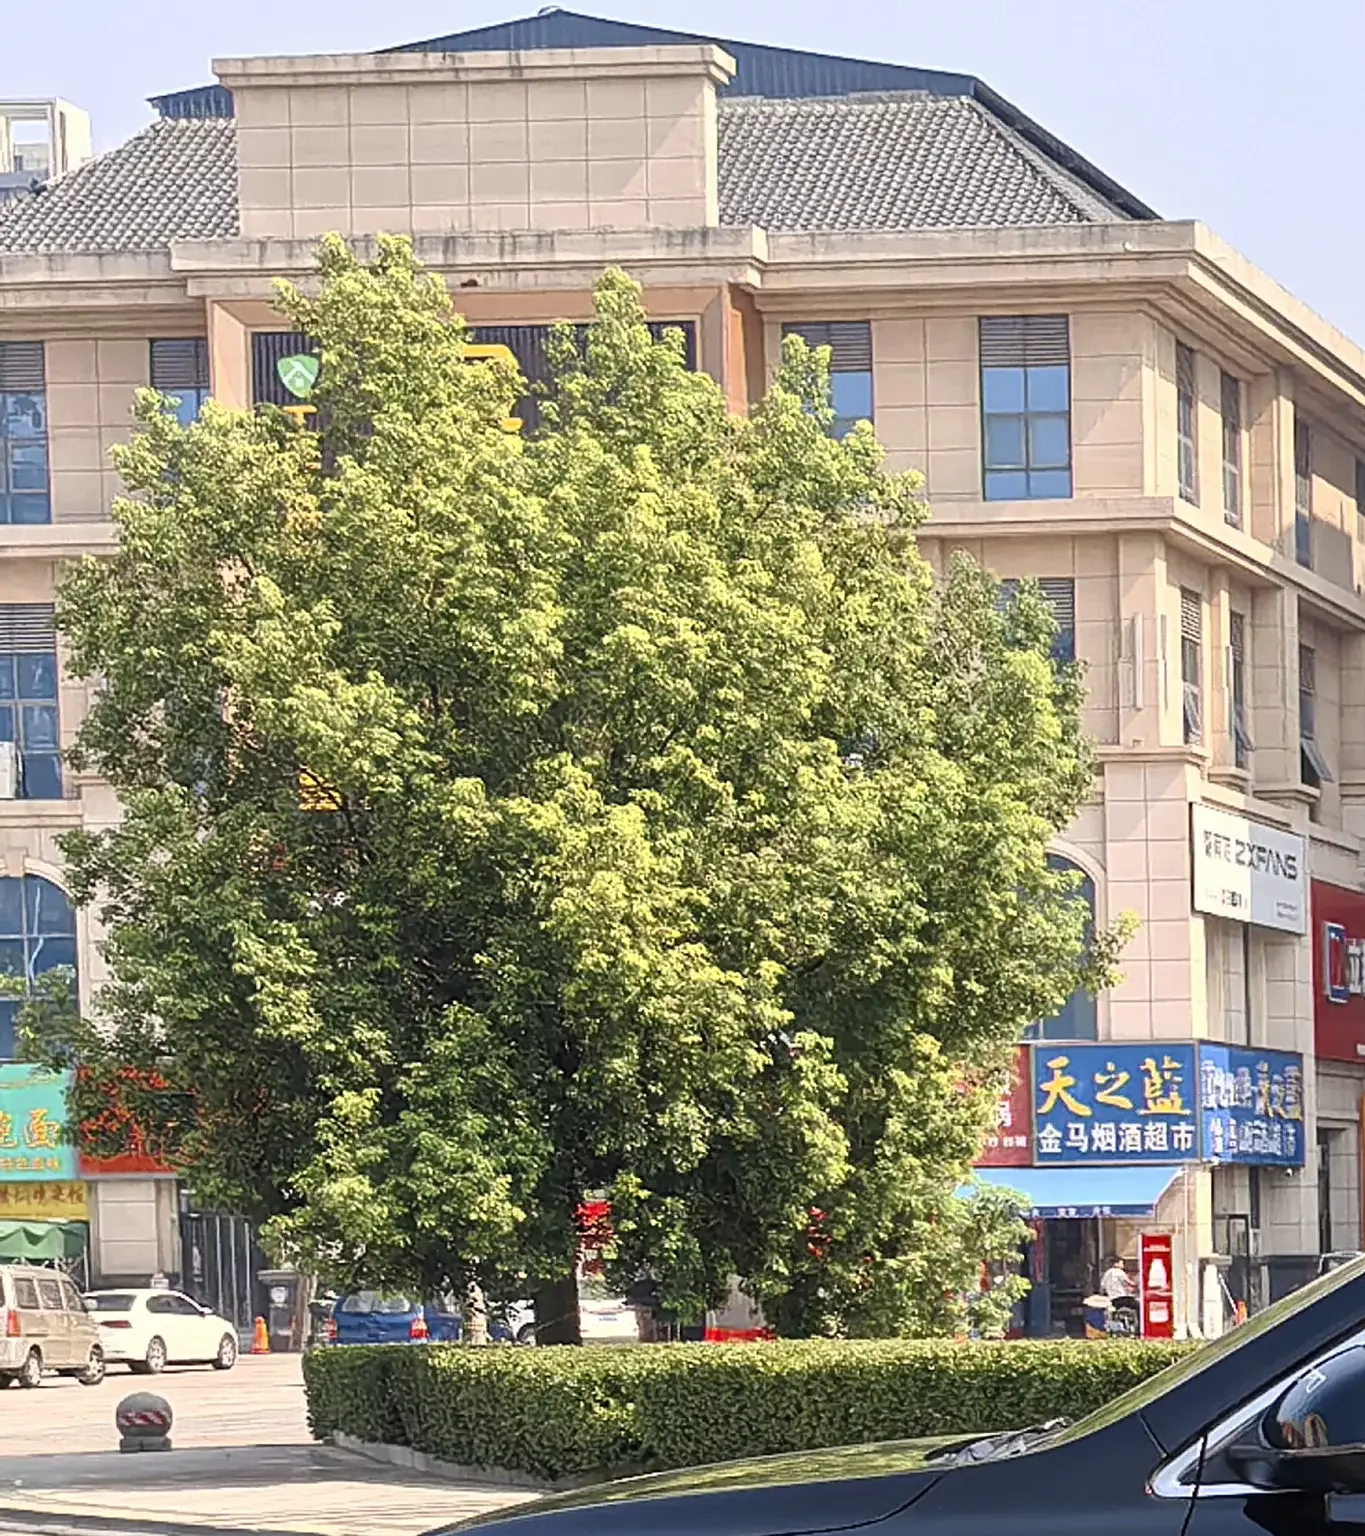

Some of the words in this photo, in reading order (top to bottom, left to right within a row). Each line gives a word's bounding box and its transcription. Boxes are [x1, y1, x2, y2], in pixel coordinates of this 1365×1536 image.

[1038, 1121, 1195, 1153] 金马烟酒超市
